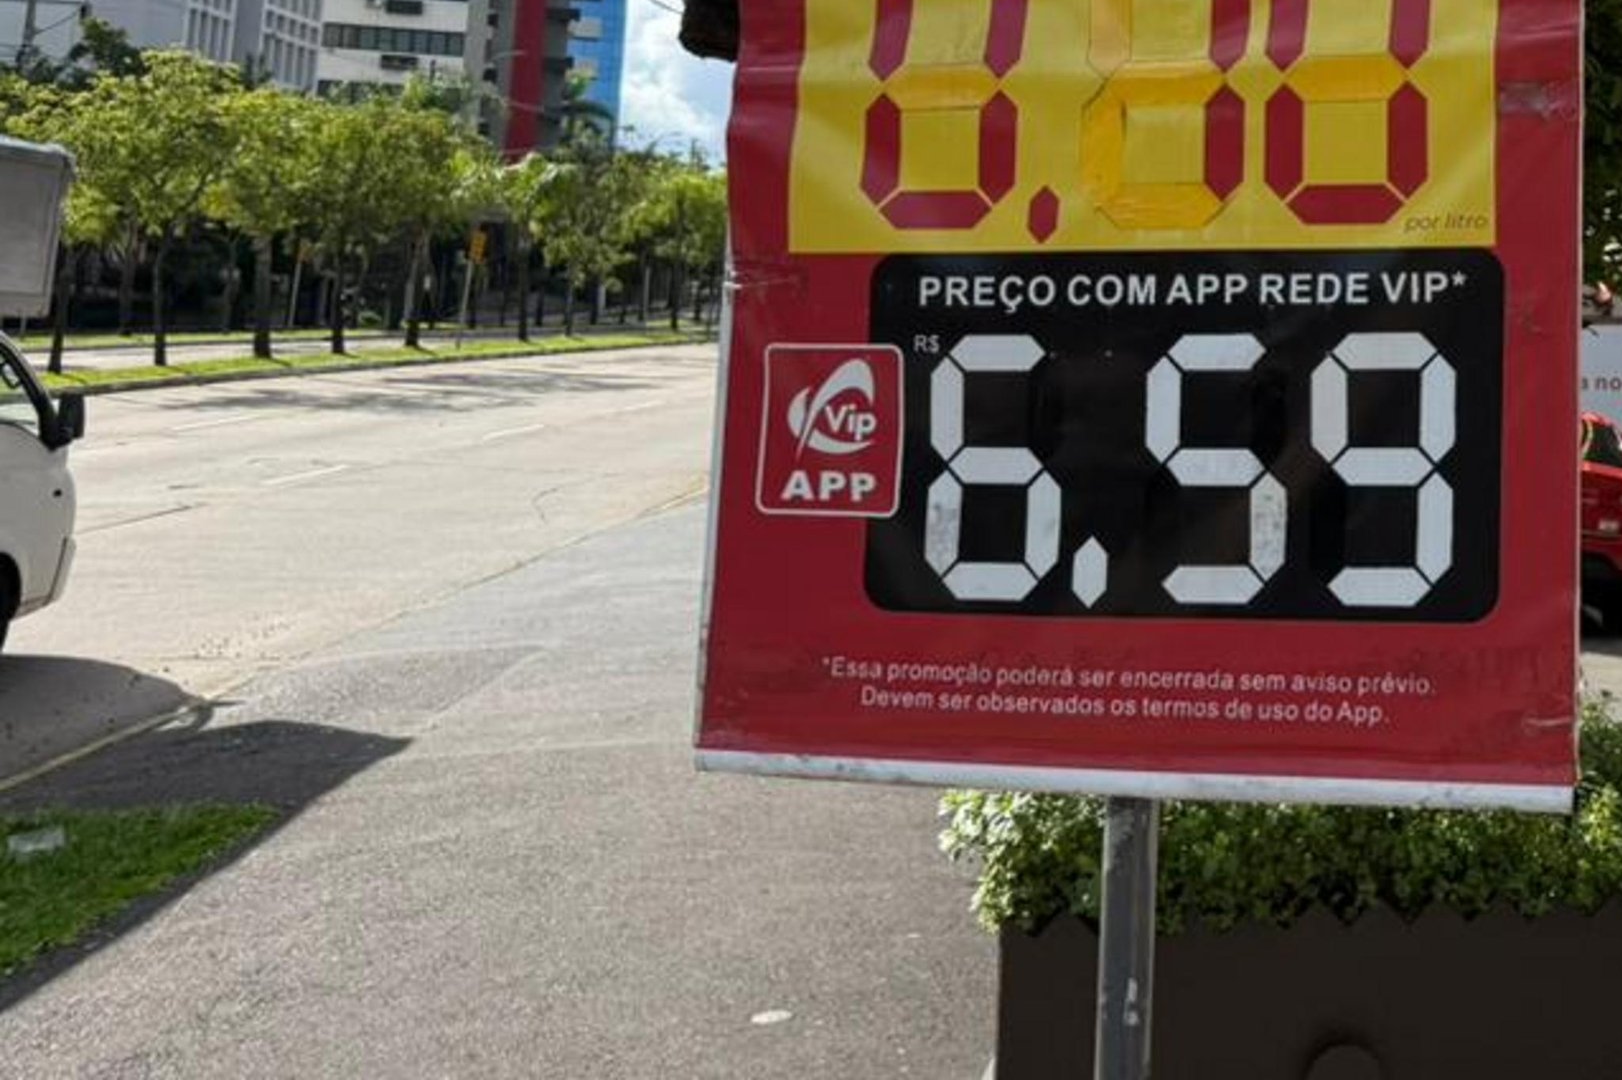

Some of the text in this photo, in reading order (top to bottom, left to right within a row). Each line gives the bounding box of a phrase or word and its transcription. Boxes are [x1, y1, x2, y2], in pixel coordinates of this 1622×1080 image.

[1404, 212, 1488, 234] por litro
[919, 275, 1056, 314] PREÇO
[1067, 274, 1156, 306] COM
[1166, 273, 1248, 305] APP
[1260, 272, 1370, 304] REDE
[913, 335, 940, 353] R$
[825, 404, 877, 441] Vip
[781, 470, 877, 502] APP
[887, 662, 992, 685] promoção
[997, 663, 1073, 688] poderá
[1080, 669, 1114, 686] ser
[1120, 669, 1234, 690] encerrada
[1239, 674, 1285, 691] sem
[1291, 673, 1352, 692] aviso
[860, 685, 933, 708] Devem
[938, 692, 971, 709] ser
[976, 692, 1105, 714] observados
[1111, 700, 1136, 716] os
[1142, 697, 1220, 718] termos
[1224, 699, 1251, 719] de
[1257, 704, 1298, 721] uso
[1303, 700, 1333, 721] do
